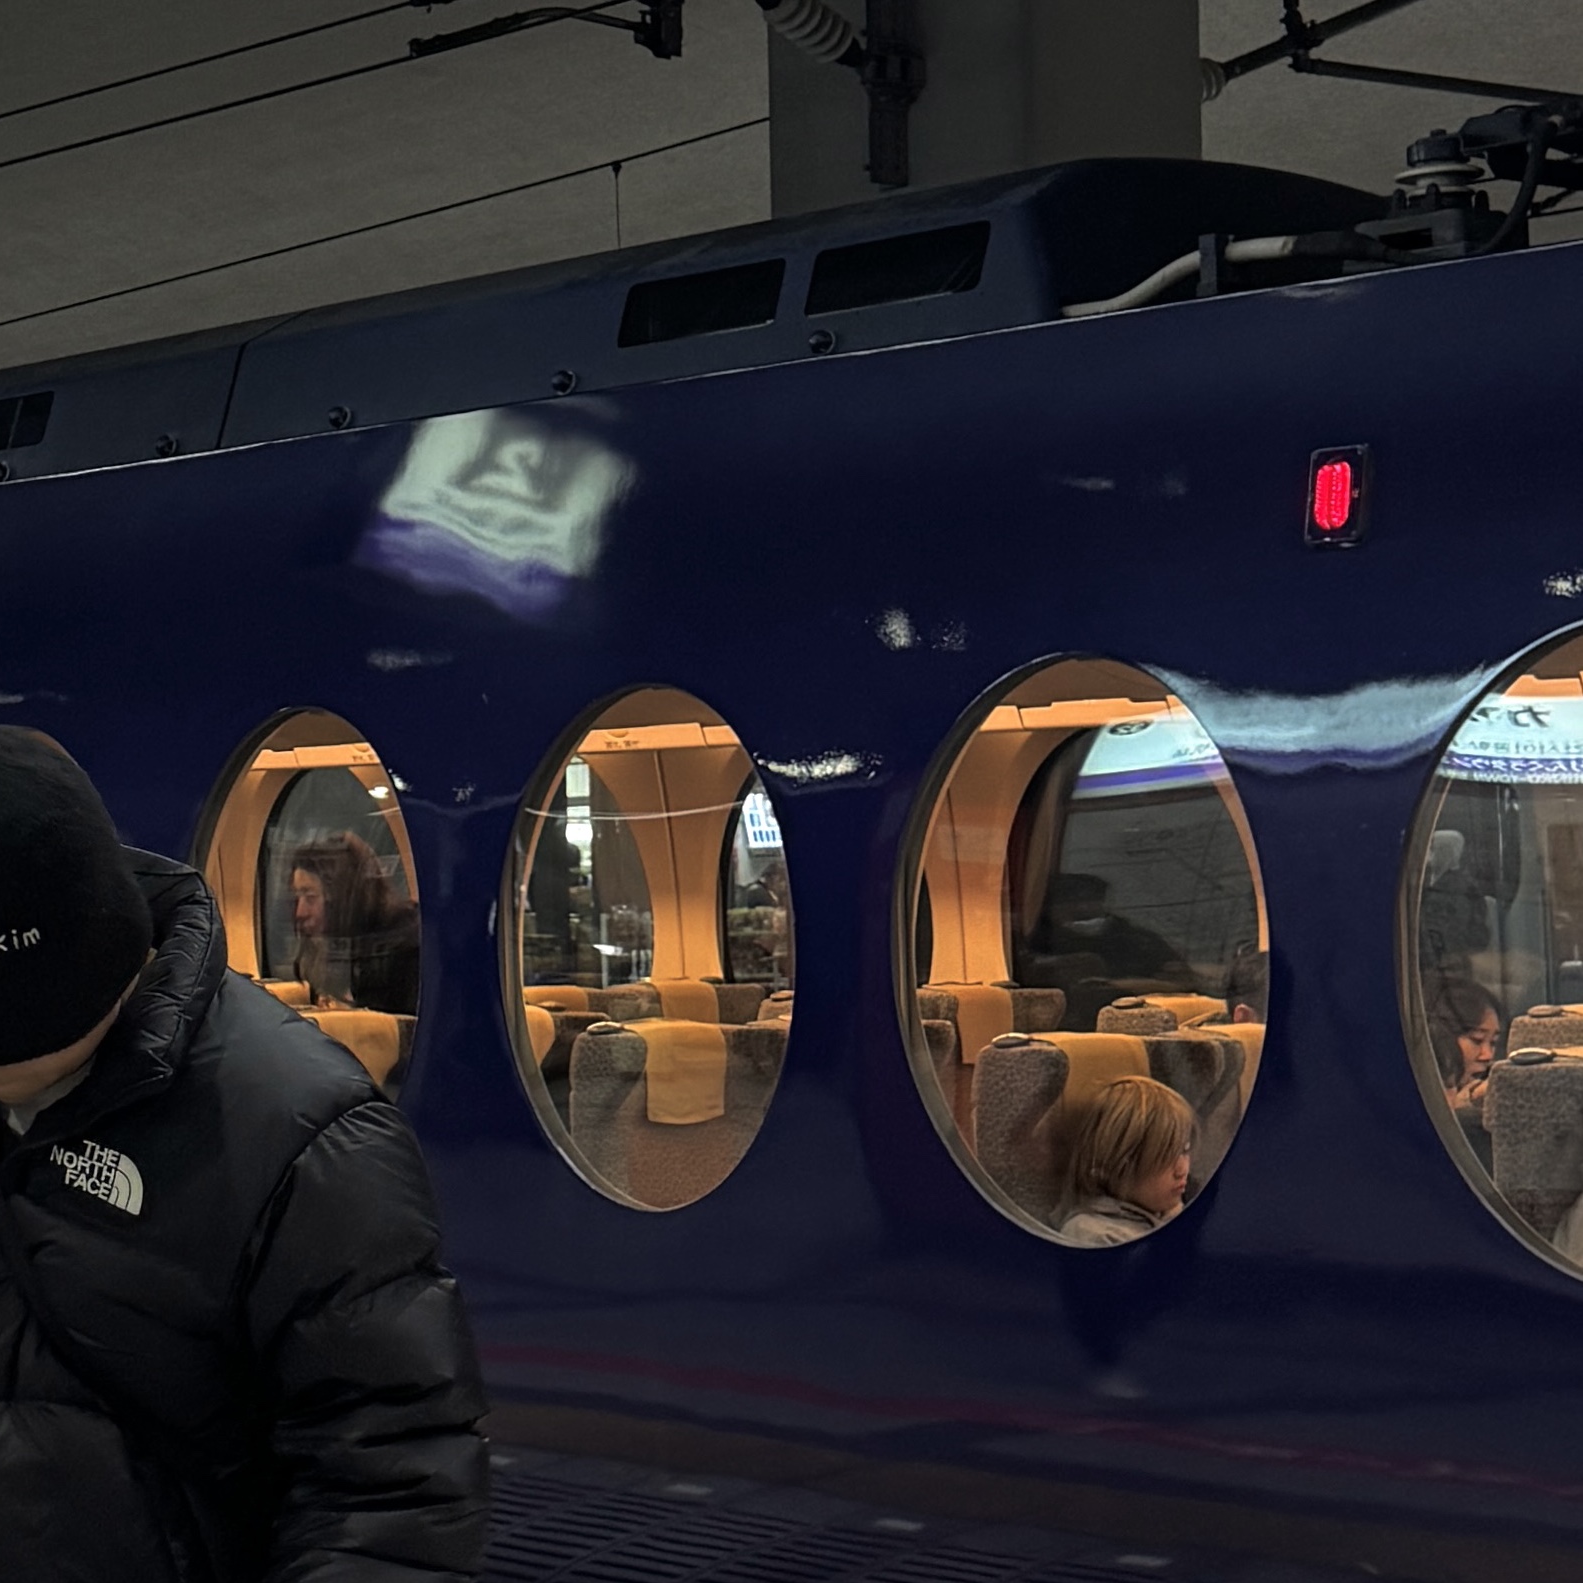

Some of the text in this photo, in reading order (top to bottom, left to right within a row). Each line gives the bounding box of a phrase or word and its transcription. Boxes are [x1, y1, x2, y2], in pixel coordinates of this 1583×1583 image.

[49, 1145, 117, 1185] NORTH
[83, 1139, 120, 1168] THE
[64, 1168, 112, 1201] FACE
